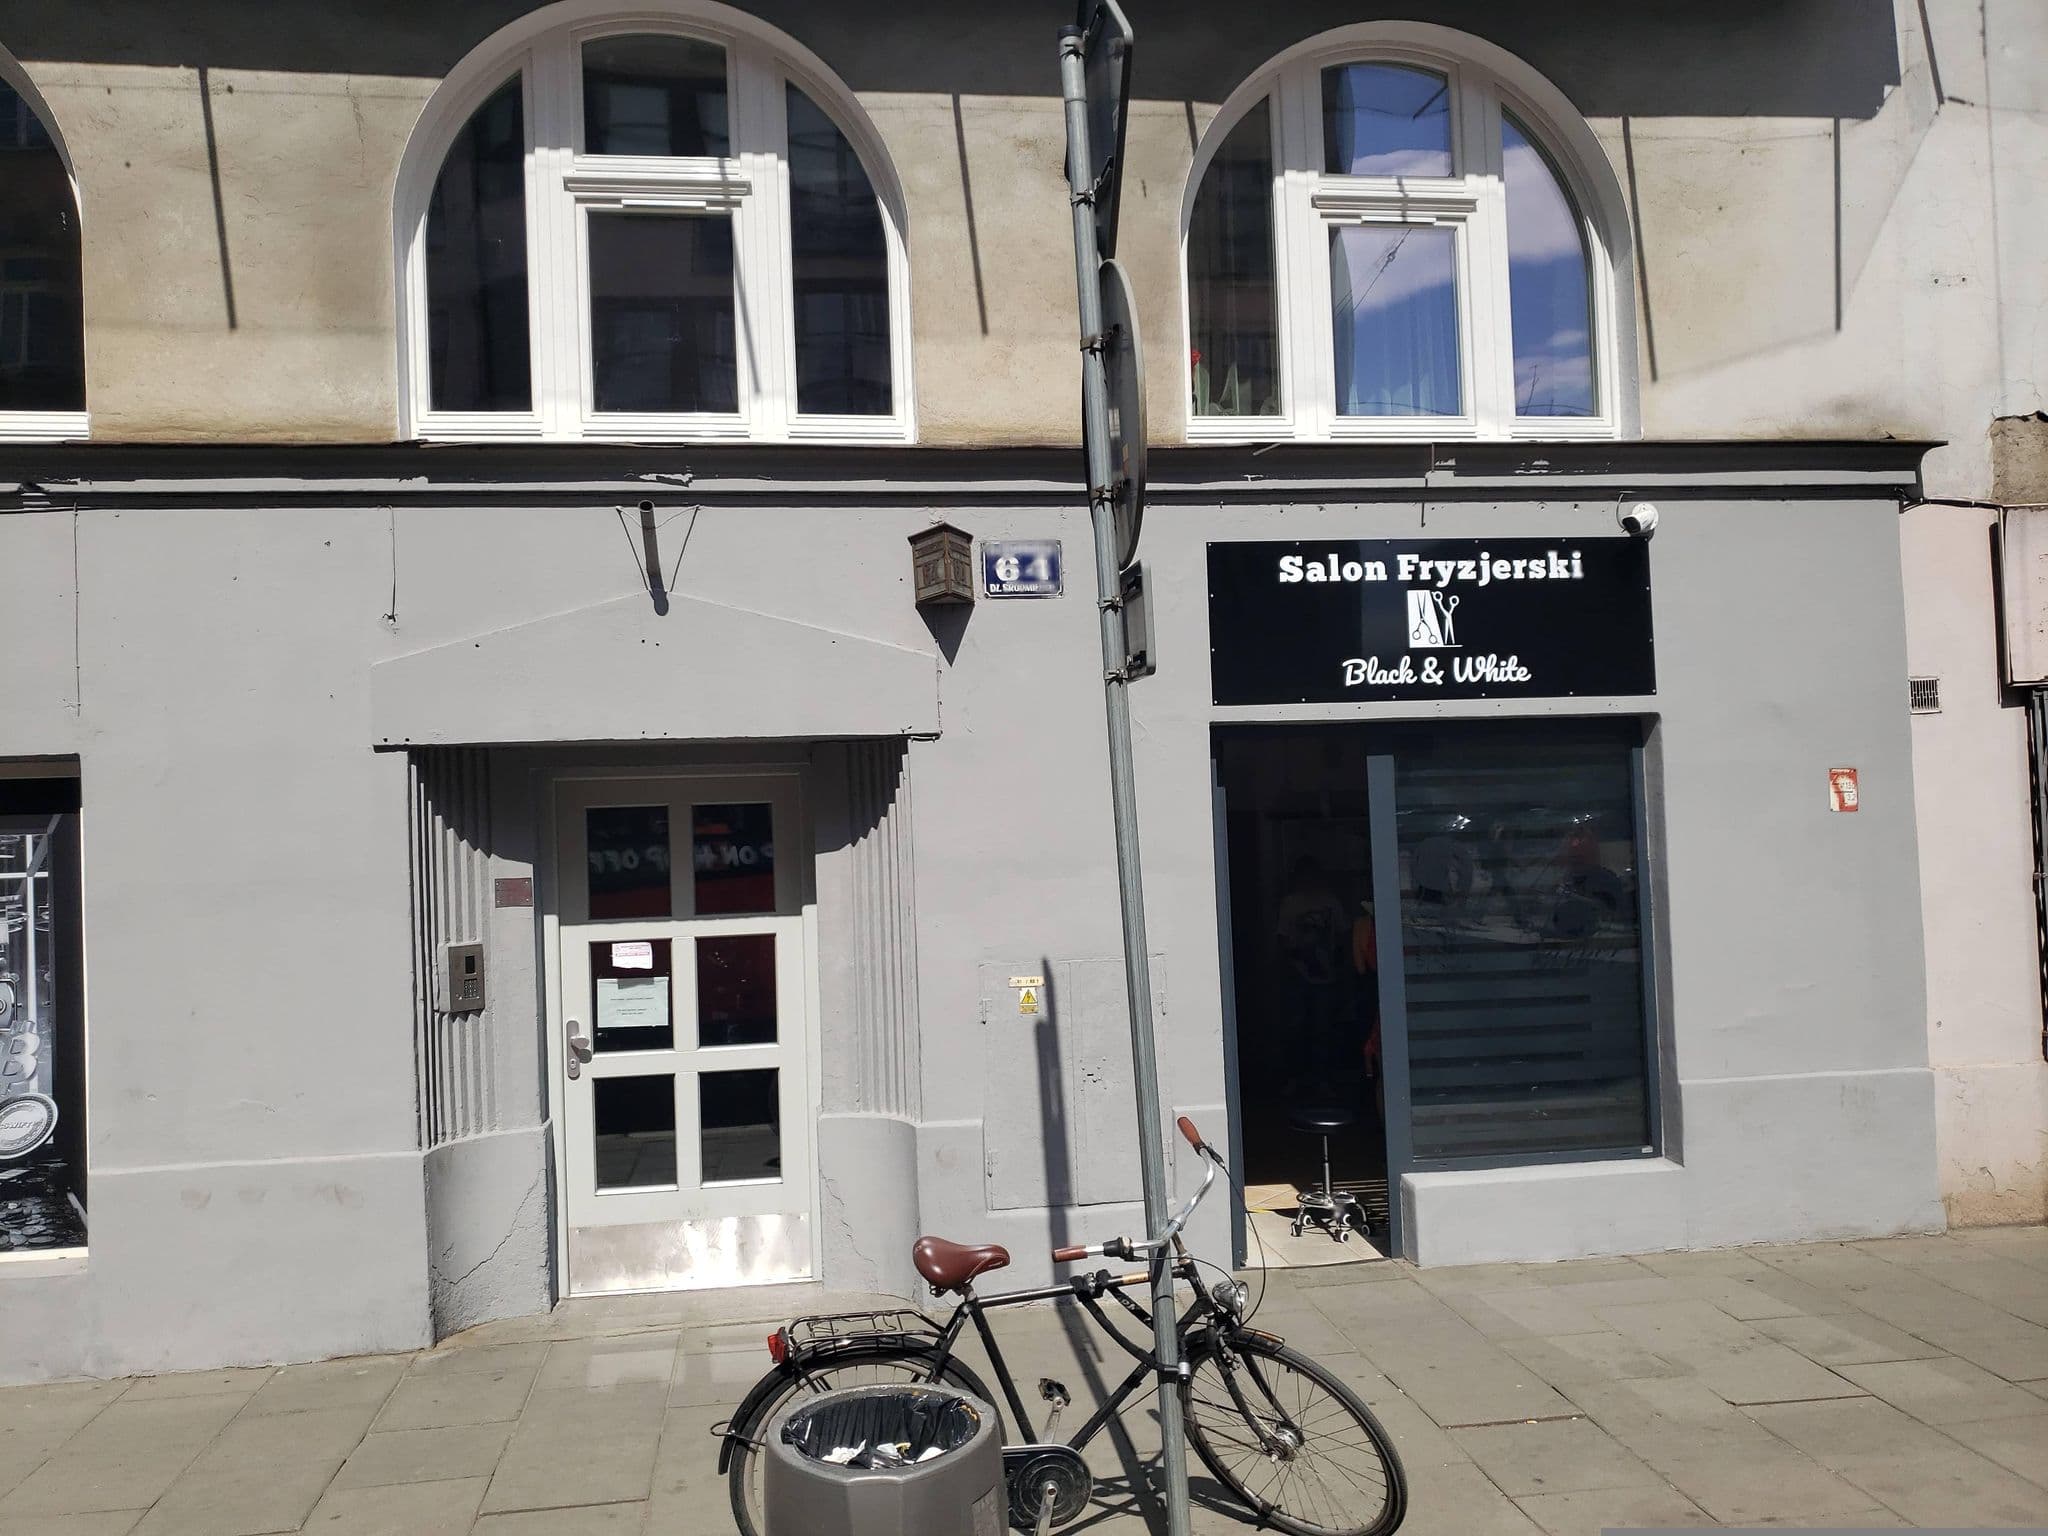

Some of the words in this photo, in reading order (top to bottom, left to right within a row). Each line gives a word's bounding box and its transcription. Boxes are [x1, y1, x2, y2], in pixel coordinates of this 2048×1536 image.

[1279, 553, 1388, 583] Salon
[1396, 551, 1584, 588] Fryzjerski
[1342, 655, 1418, 687] Black
[1421, 656, 1445, 685] &
[1453, 653, 1532, 683] White
